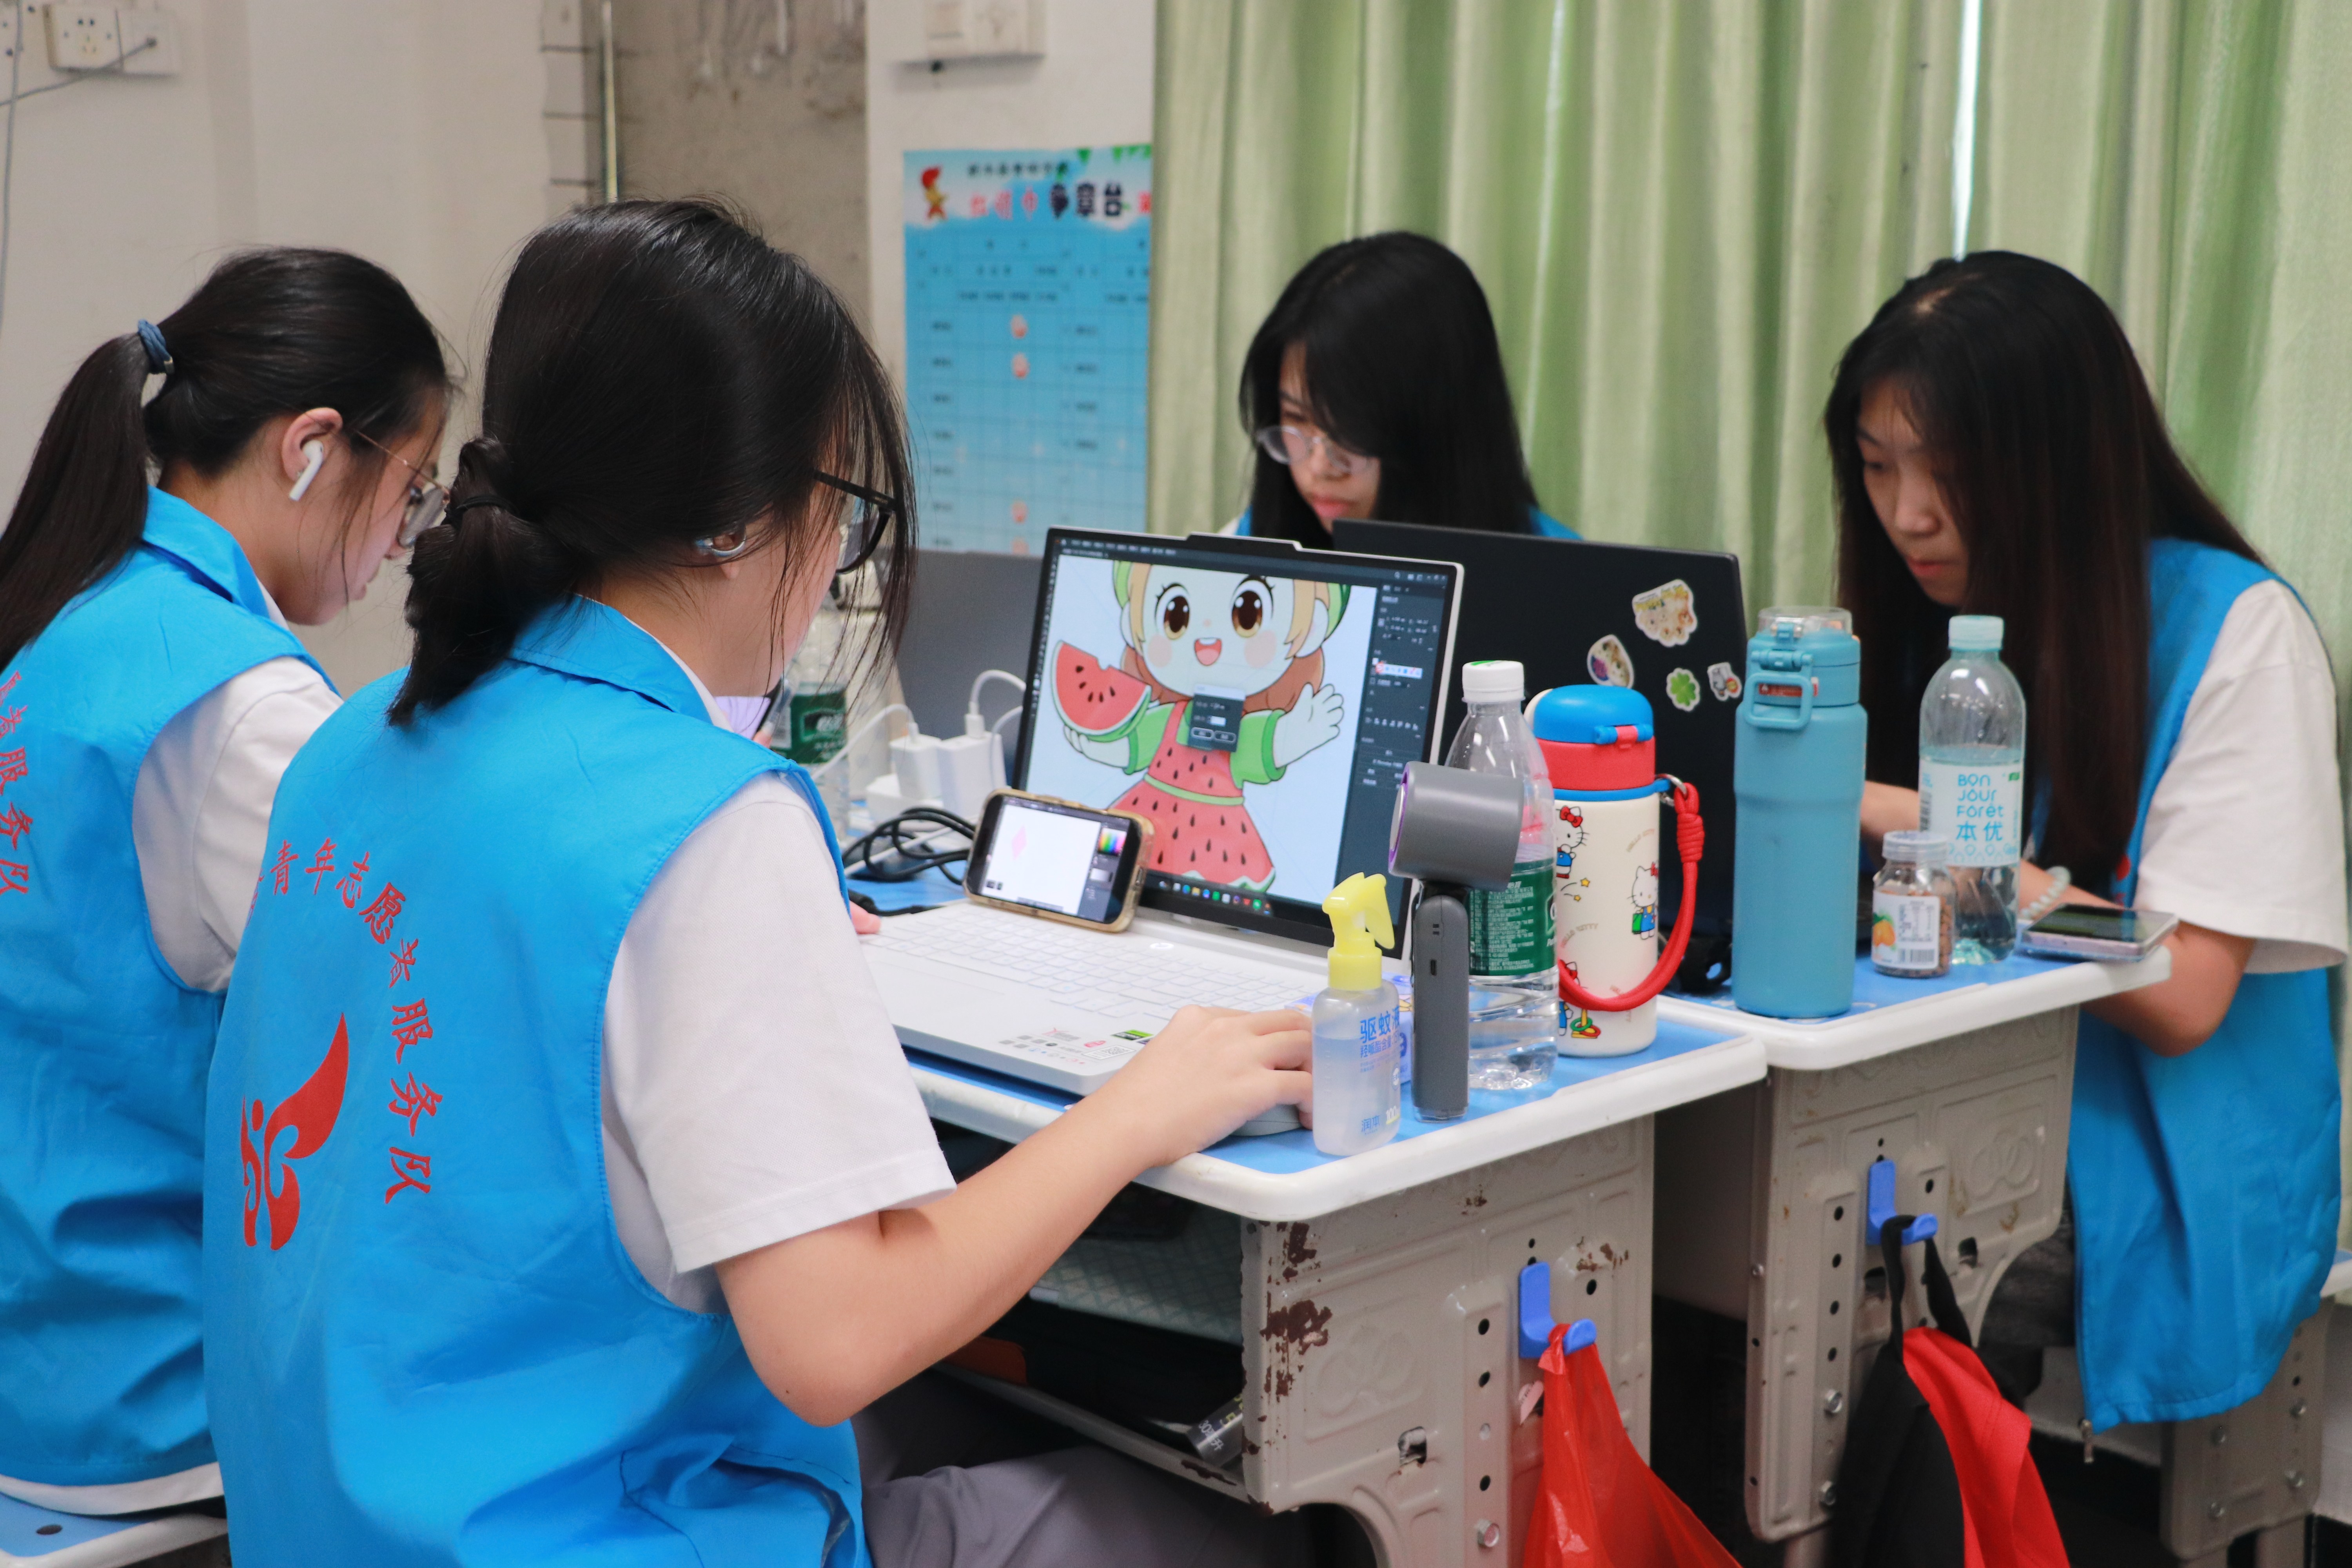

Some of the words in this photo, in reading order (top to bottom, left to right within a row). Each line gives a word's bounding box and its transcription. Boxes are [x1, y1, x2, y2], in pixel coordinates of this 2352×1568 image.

[1956, 821, 2004, 841] 本优
[245, 837, 443, 1205] 青年志愿者服务队
[1361, 1115, 1380, 1132] 润本
